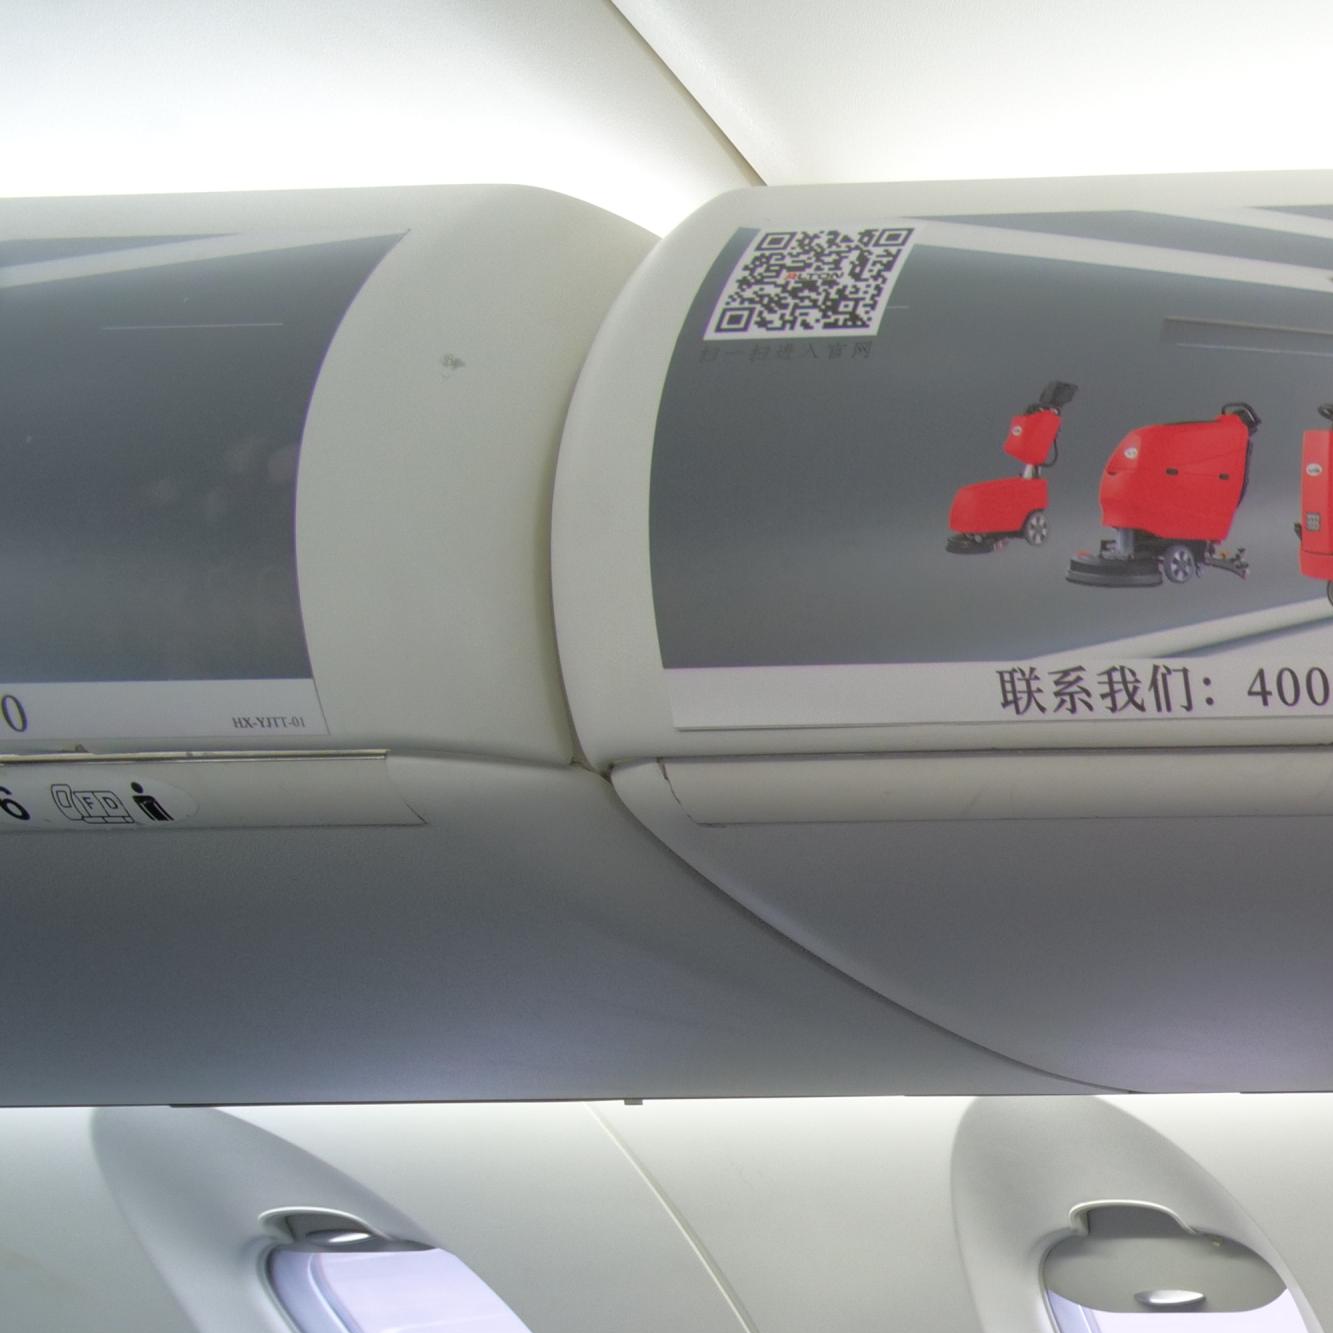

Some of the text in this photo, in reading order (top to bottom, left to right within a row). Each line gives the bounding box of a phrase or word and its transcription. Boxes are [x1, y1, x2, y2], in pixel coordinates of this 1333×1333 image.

[698, 340, 874, 363] 扫一扫进入官网
